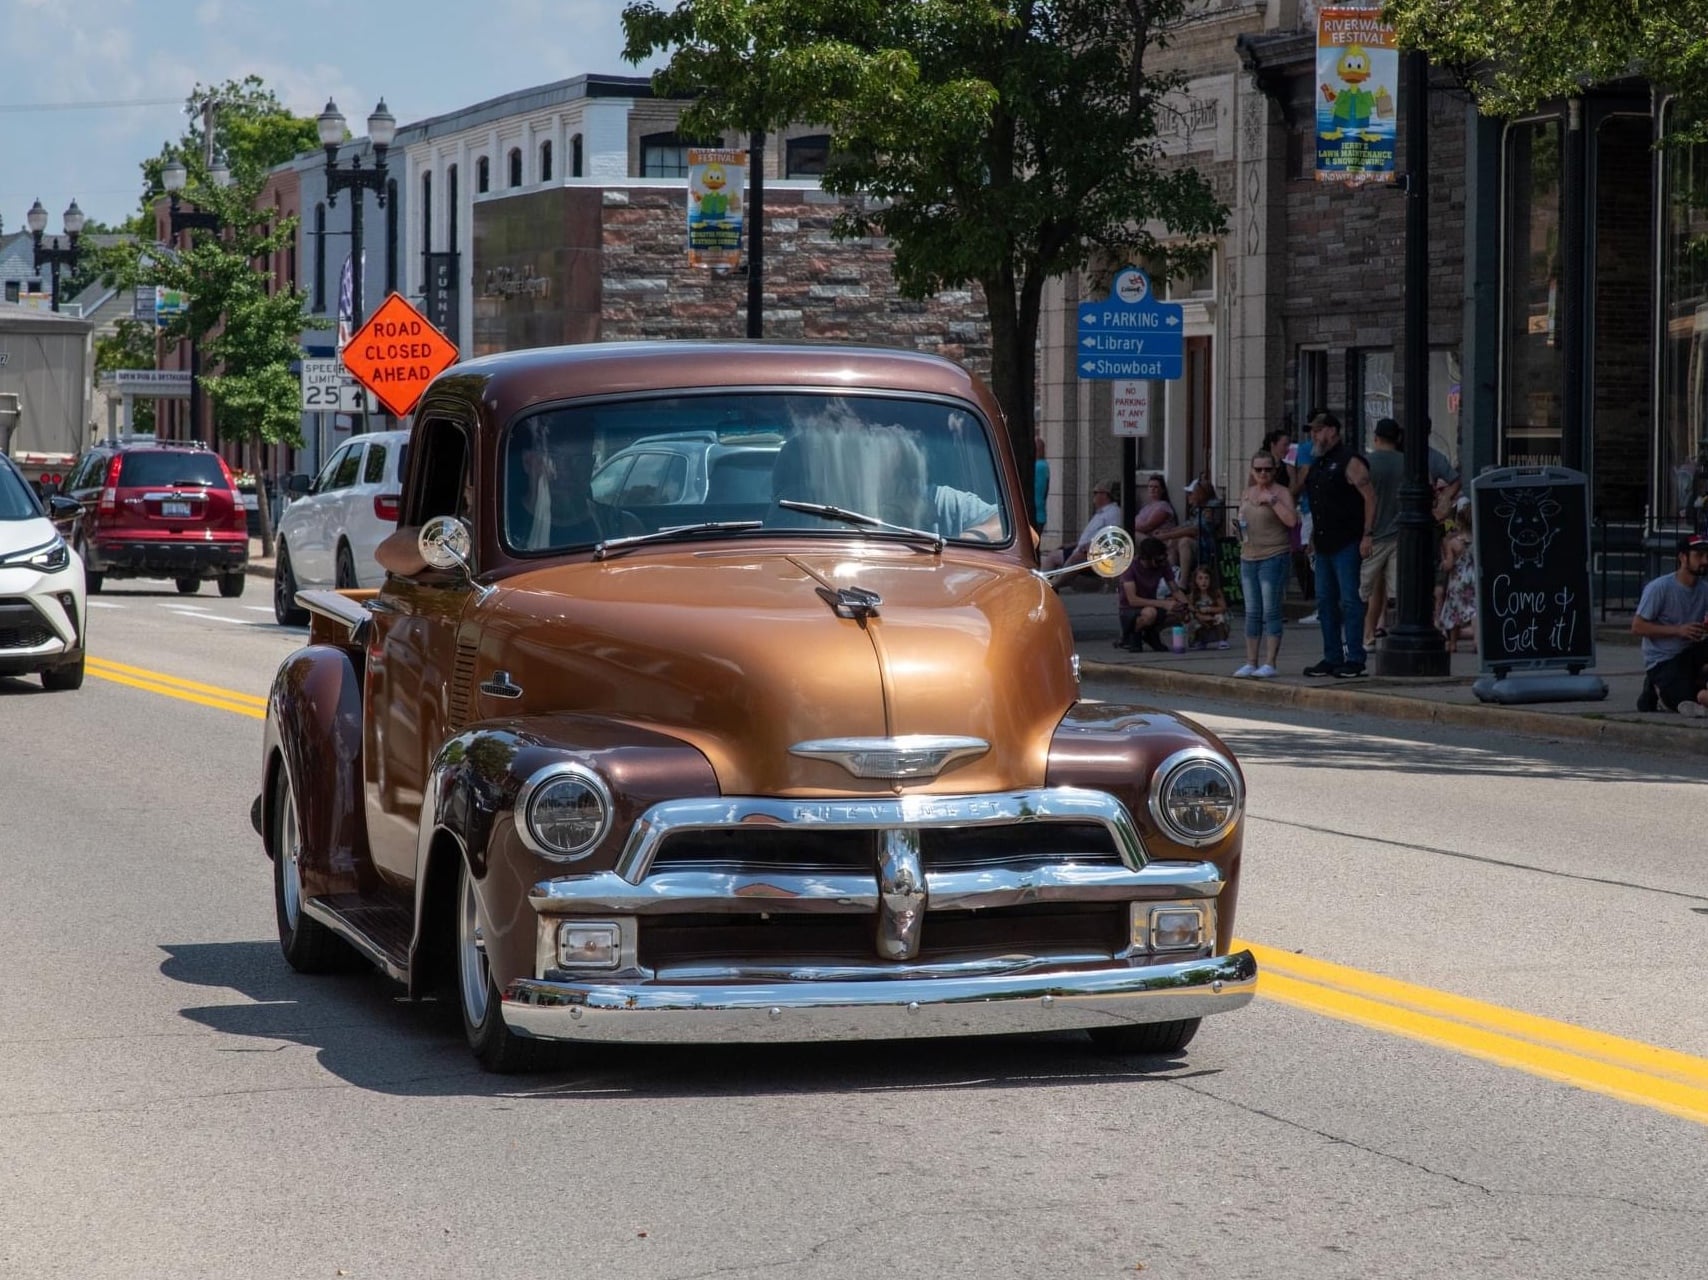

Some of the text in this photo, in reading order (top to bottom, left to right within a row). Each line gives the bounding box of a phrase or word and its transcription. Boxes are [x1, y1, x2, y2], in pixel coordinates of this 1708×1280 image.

[1324, 19, 1394, 32] RIVERWALK
[1332, 32, 1386, 45] FESTIVAL
[698, 153, 736, 163] FESTIVAL
[1318, 150, 1393, 159] LAWN MAINTENANCE
[1103, 311, 1159, 328] PARKING
[373, 321, 421, 338] ROAD
[1096, 334, 1144, 354] Library
[365, 343, 431, 361] CLOSED
[305, 364, 336, 374] SPEE
[372, 365, 430, 383] AHEAD
[1096, 359, 1162, 375] Showboat
[308, 374, 335, 385] LIMIT
[306, 386, 339, 404] 25
[1126, 387, 1136, 395] NO
[1115, 398, 1146, 406] PARKING
[1117, 409, 1144, 417] AT ANY
[1123, 420, 1138, 428] TIME
[1493, 574, 1546, 617] Come
[1502, 609, 1576, 653] Get it!
[793, 801, 1000, 820] CHEVOLET
